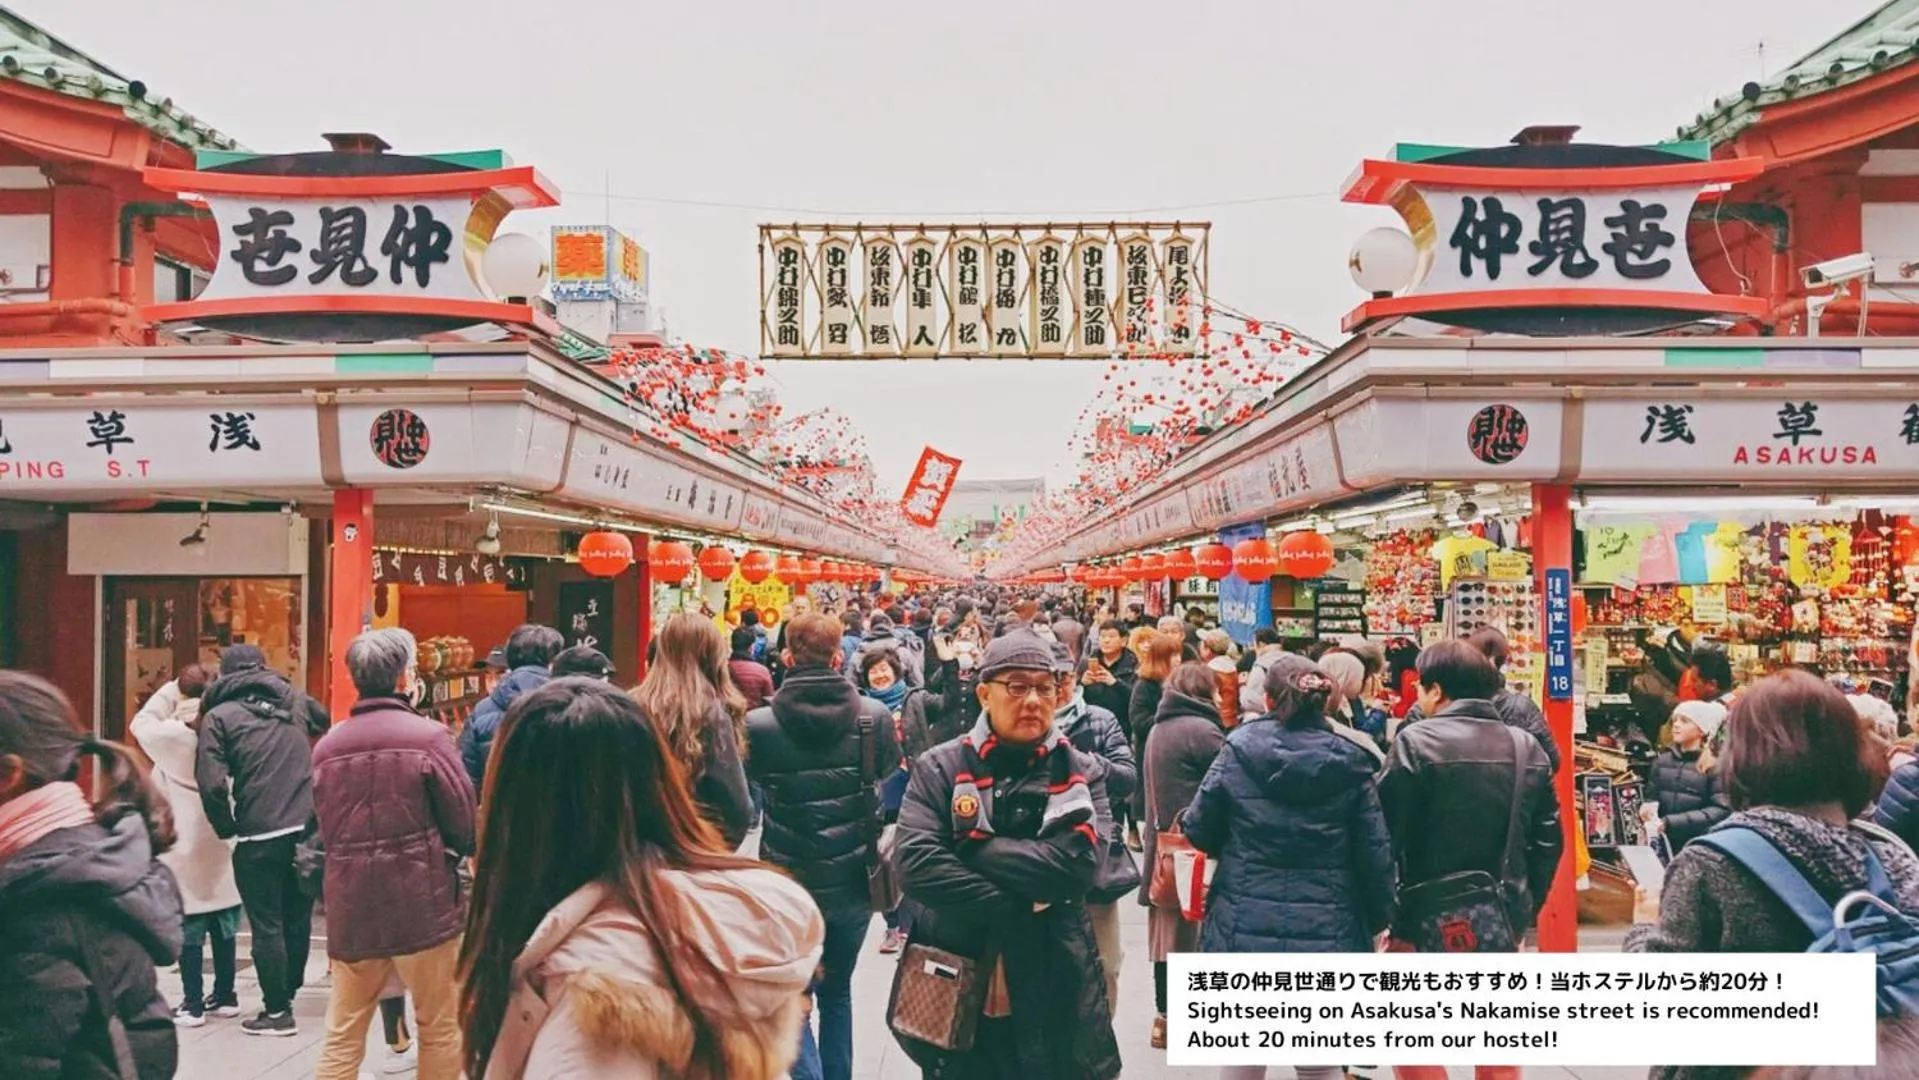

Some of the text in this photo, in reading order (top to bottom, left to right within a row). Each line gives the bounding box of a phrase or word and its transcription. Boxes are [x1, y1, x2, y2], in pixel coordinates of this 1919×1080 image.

[1450, 192, 1676, 281] 仲見世
[1733, 446, 1877, 465] ASAKUSA
[1552, 676, 1569, 691] 18
